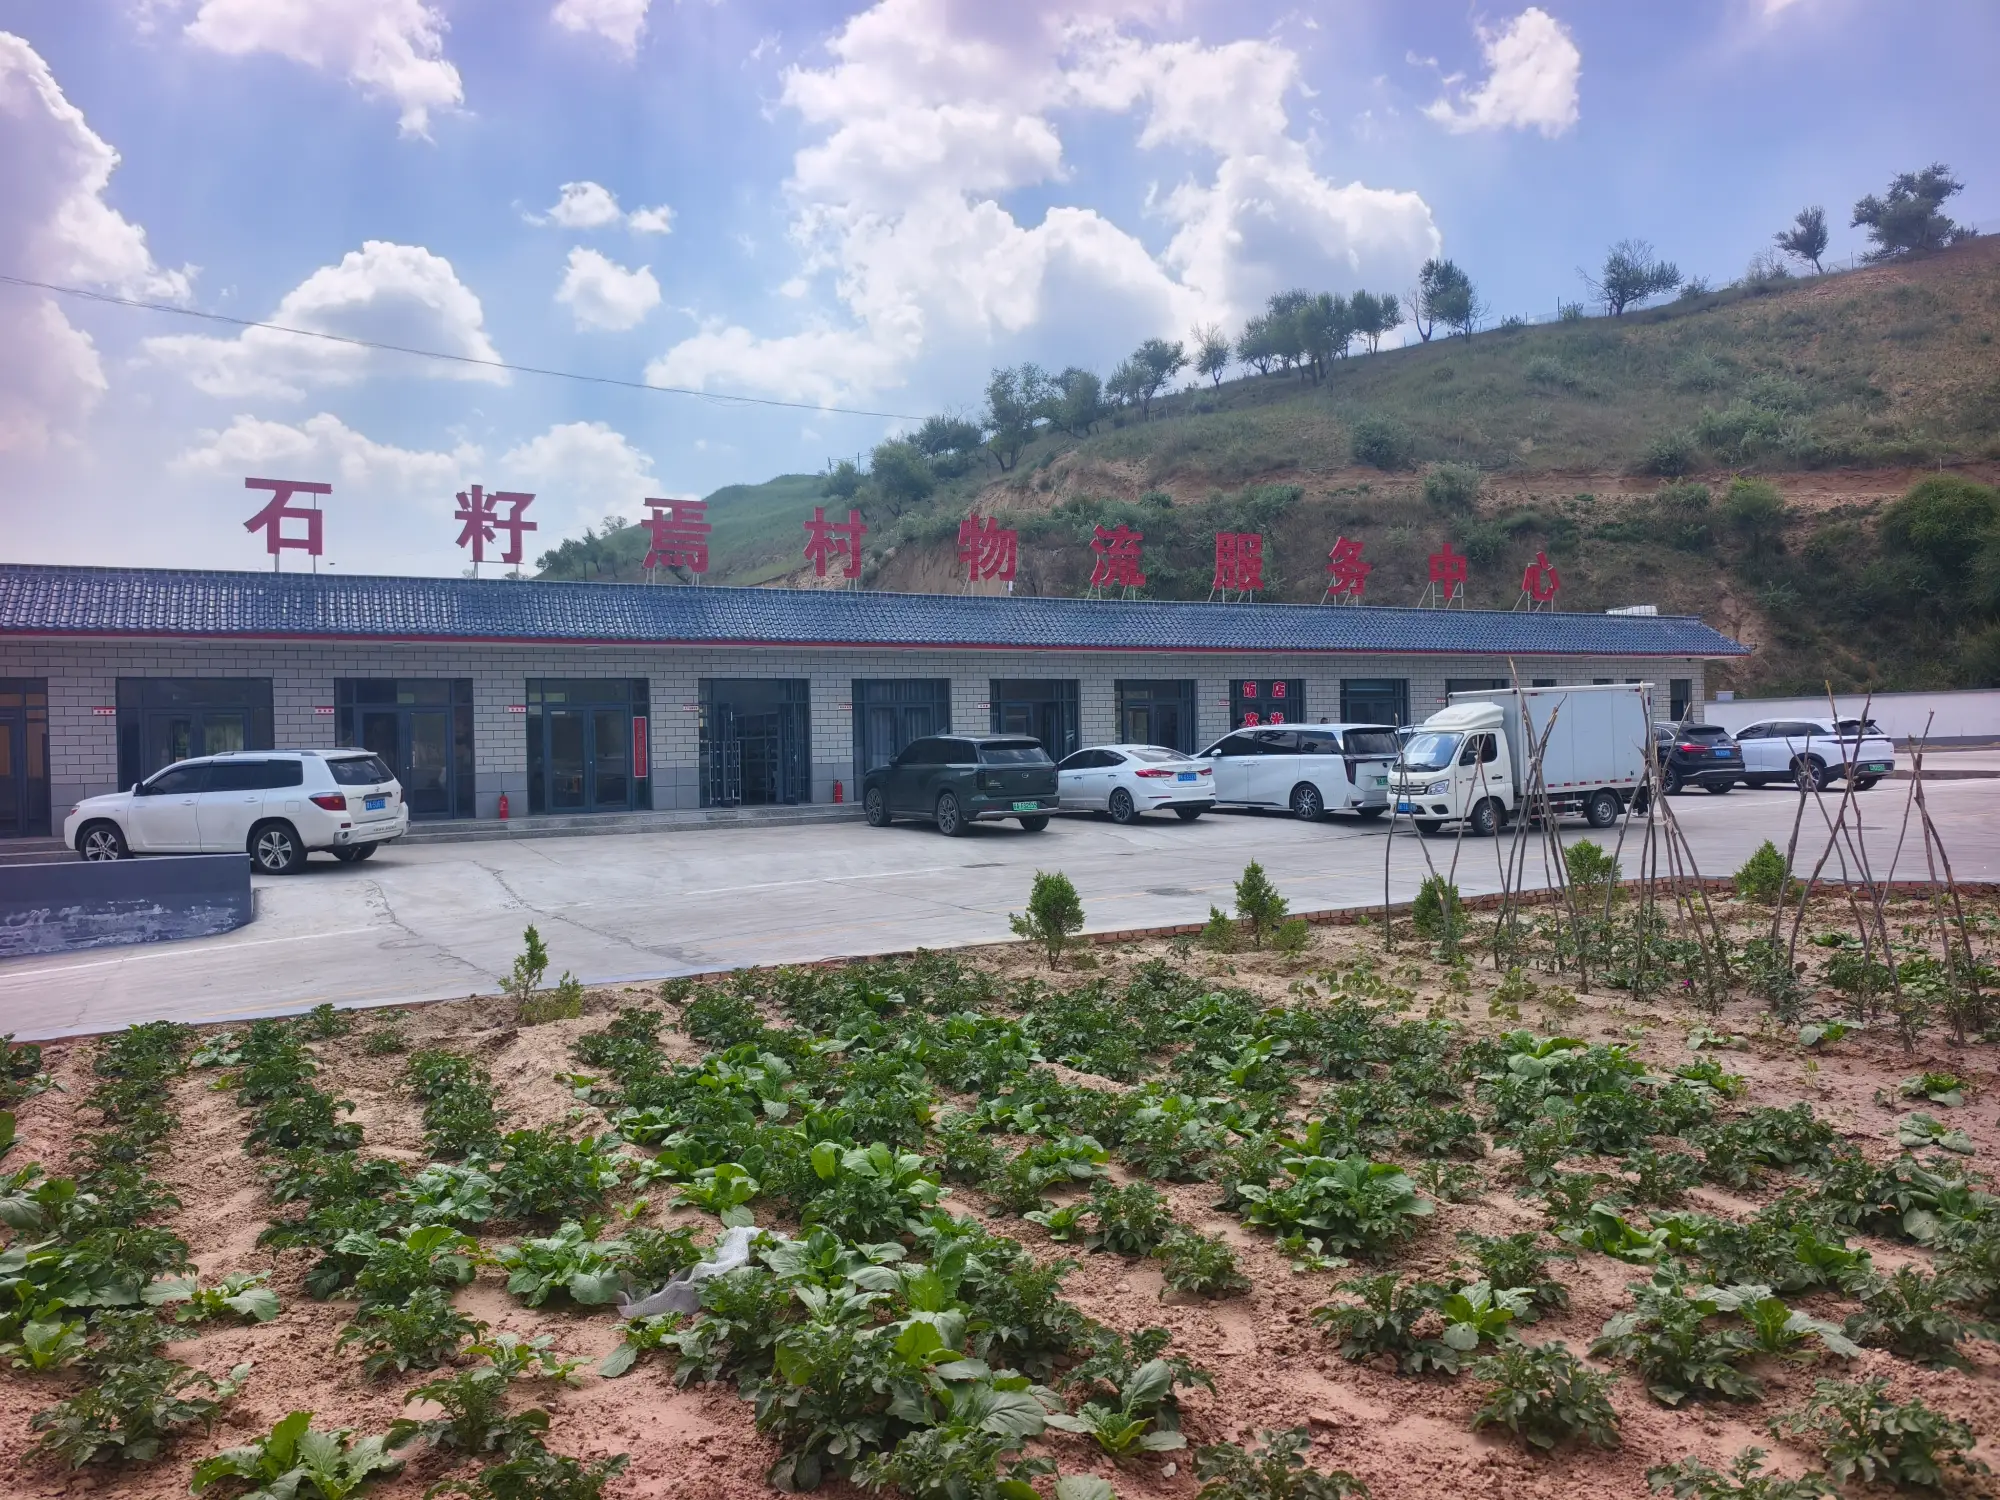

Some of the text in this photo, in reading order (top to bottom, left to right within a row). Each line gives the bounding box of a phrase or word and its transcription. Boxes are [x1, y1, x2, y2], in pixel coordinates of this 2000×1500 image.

[244, 477, 1561, 601] 石籽焉村物流服务中心
[1243, 681, 1286, 698] 饭店
